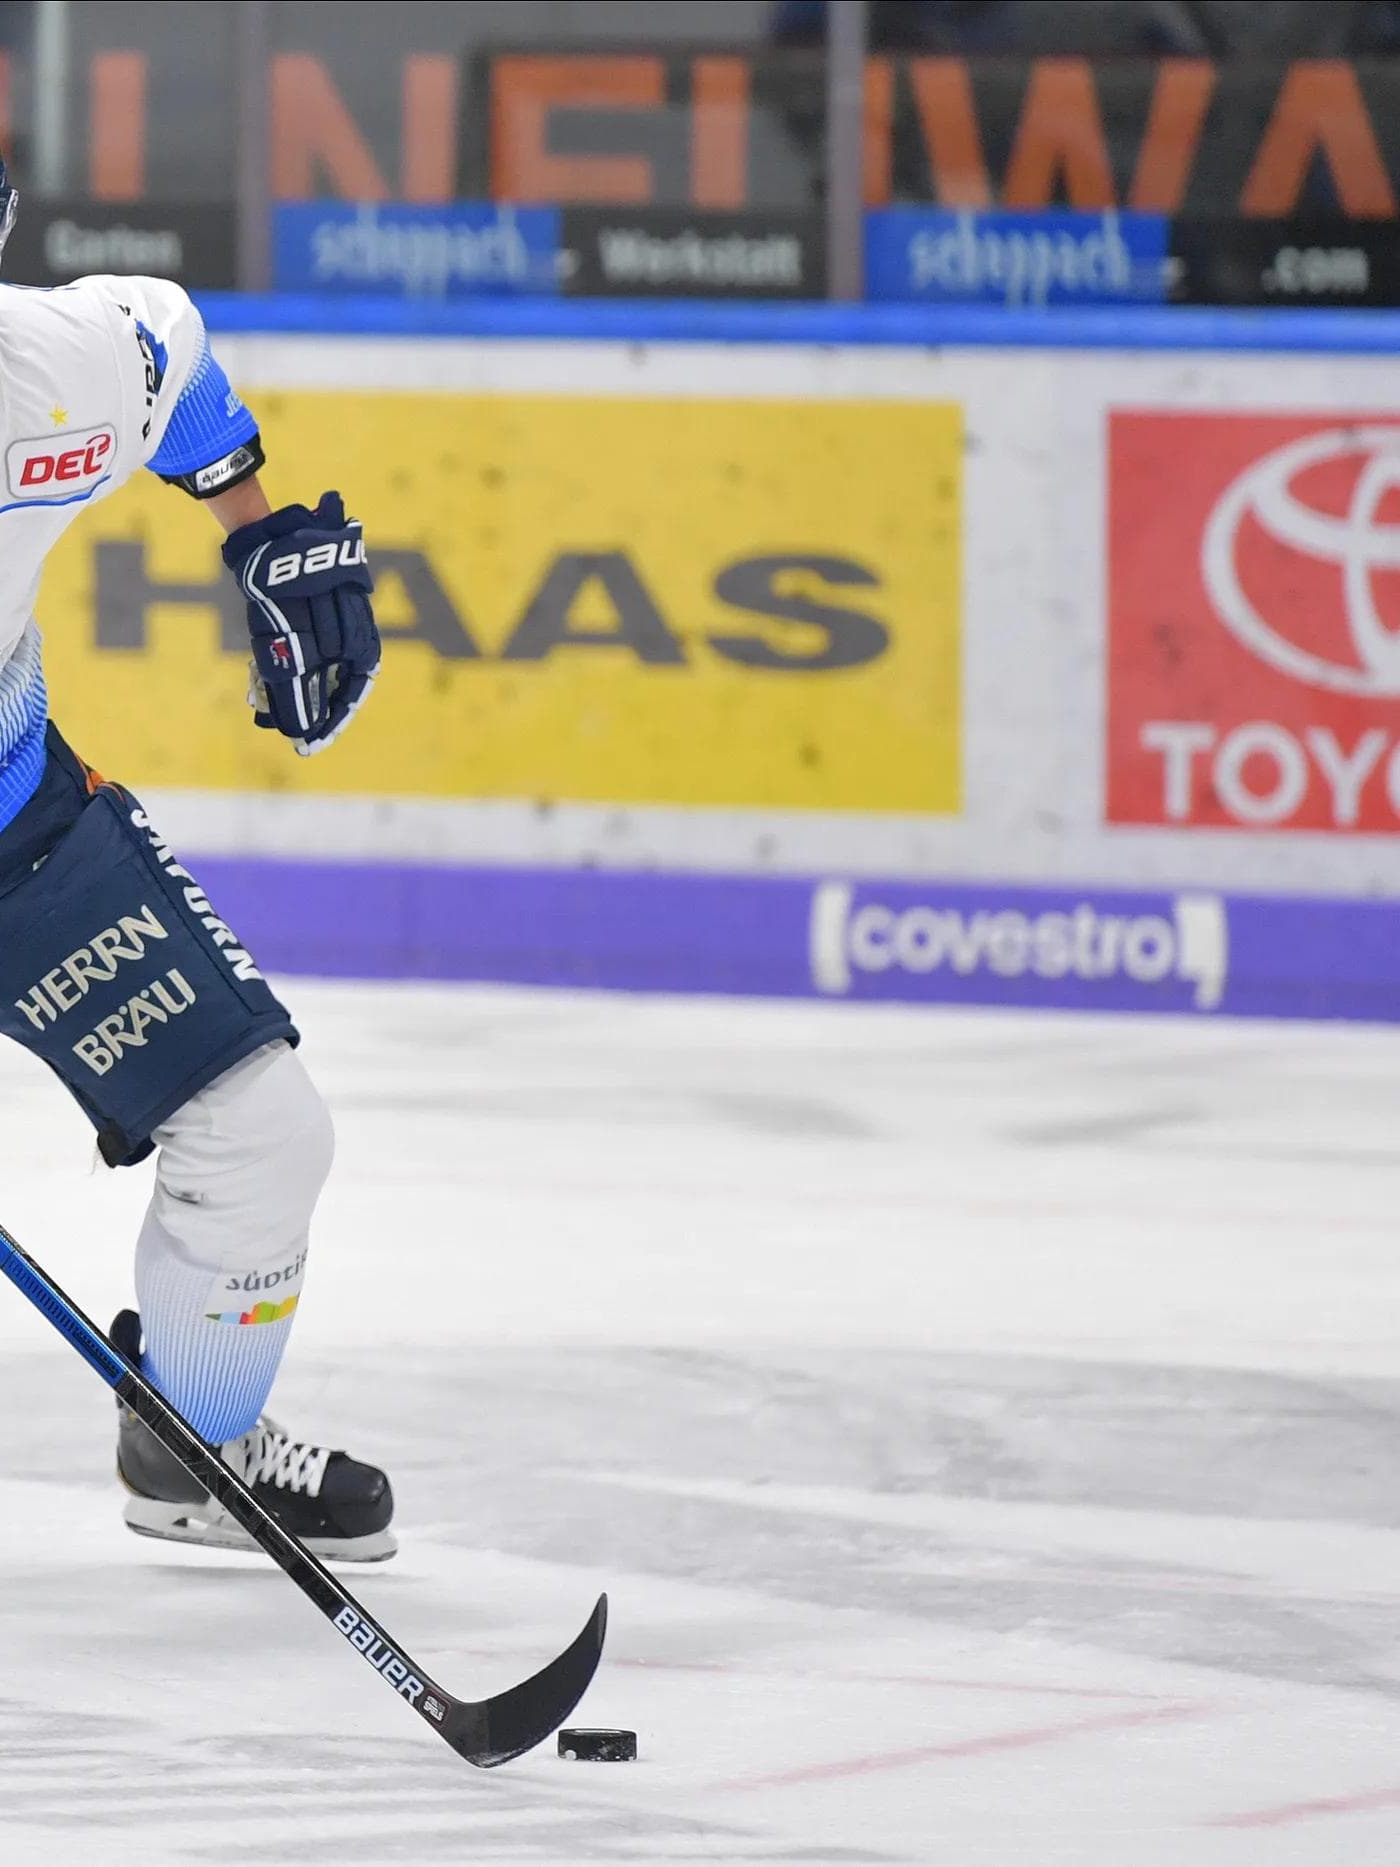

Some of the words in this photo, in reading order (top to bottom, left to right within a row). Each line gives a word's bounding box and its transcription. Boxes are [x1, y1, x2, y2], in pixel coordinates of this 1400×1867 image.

[91, 533, 892, 674] HAAS
[1141, 721, 1400, 826] TOY
[14, 904, 168, 1031] HERRN
[72, 968, 196, 1077] BRÄU
